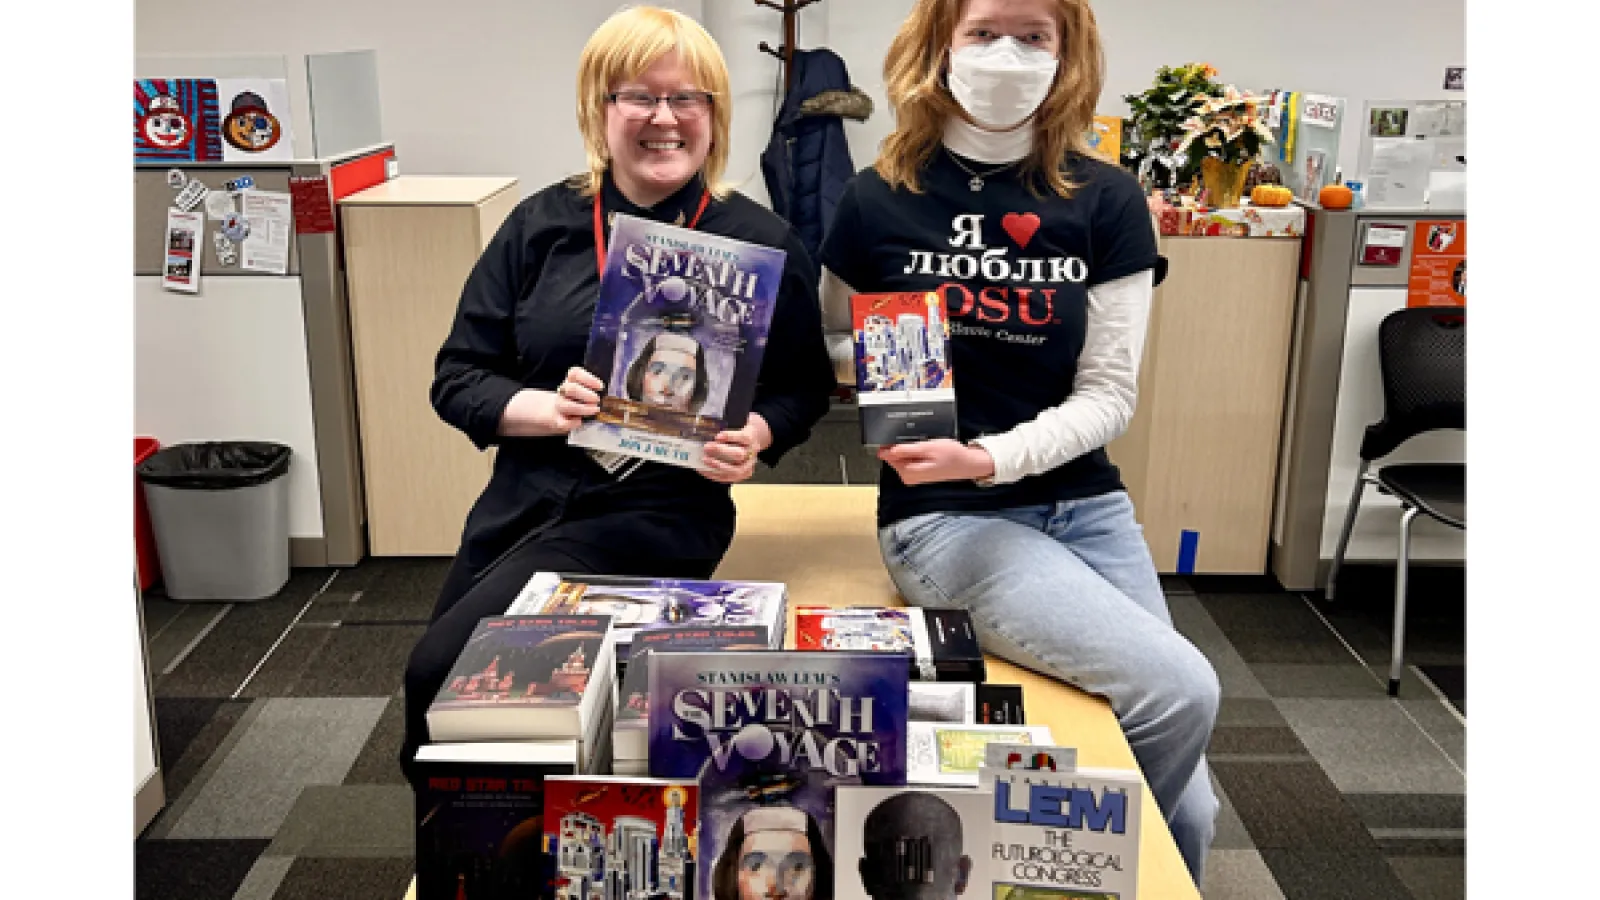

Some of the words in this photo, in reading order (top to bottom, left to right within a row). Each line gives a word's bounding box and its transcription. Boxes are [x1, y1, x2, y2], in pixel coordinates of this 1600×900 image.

[947, 214, 986, 250] Я
[903, 247, 1089, 282] люблю
[936, 281, 1057, 325] OSU
[672, 687, 876, 741] SEVENTH
[706, 724, 881, 776] VOYAGE
[994, 778, 1129, 835] LEM
[1045, 830, 1073, 848] THE
[992, 843, 1124, 872] FUTUROLOGICAL
[1012, 863, 1102, 888] CONGRESS
